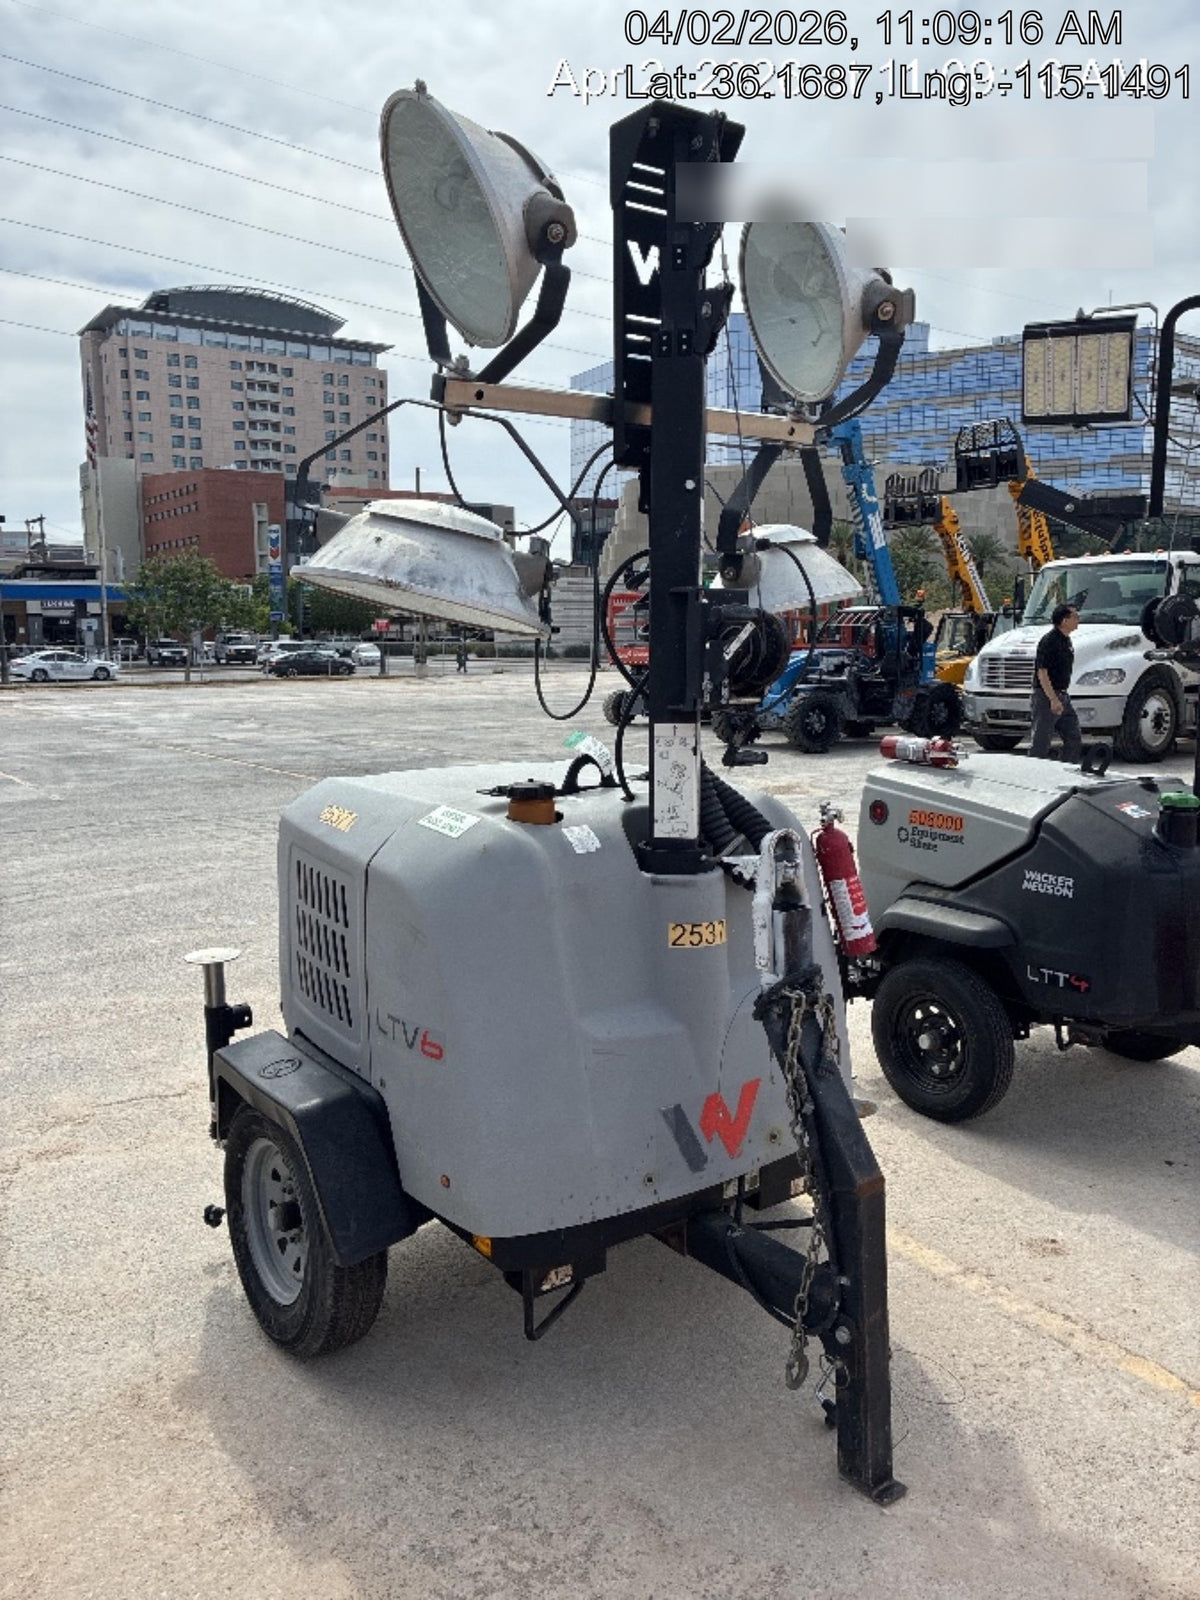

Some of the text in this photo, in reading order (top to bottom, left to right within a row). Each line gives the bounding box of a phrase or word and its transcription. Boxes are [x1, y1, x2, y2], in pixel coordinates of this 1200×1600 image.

[1022, 879, 1074, 898] NEUSON
[1024, 869, 1074, 888] WACKER
[670, 920, 725, 947] 2531
[1026, 964, 1089, 993] LTT4
[376, 1007, 444, 1060] LTV6
